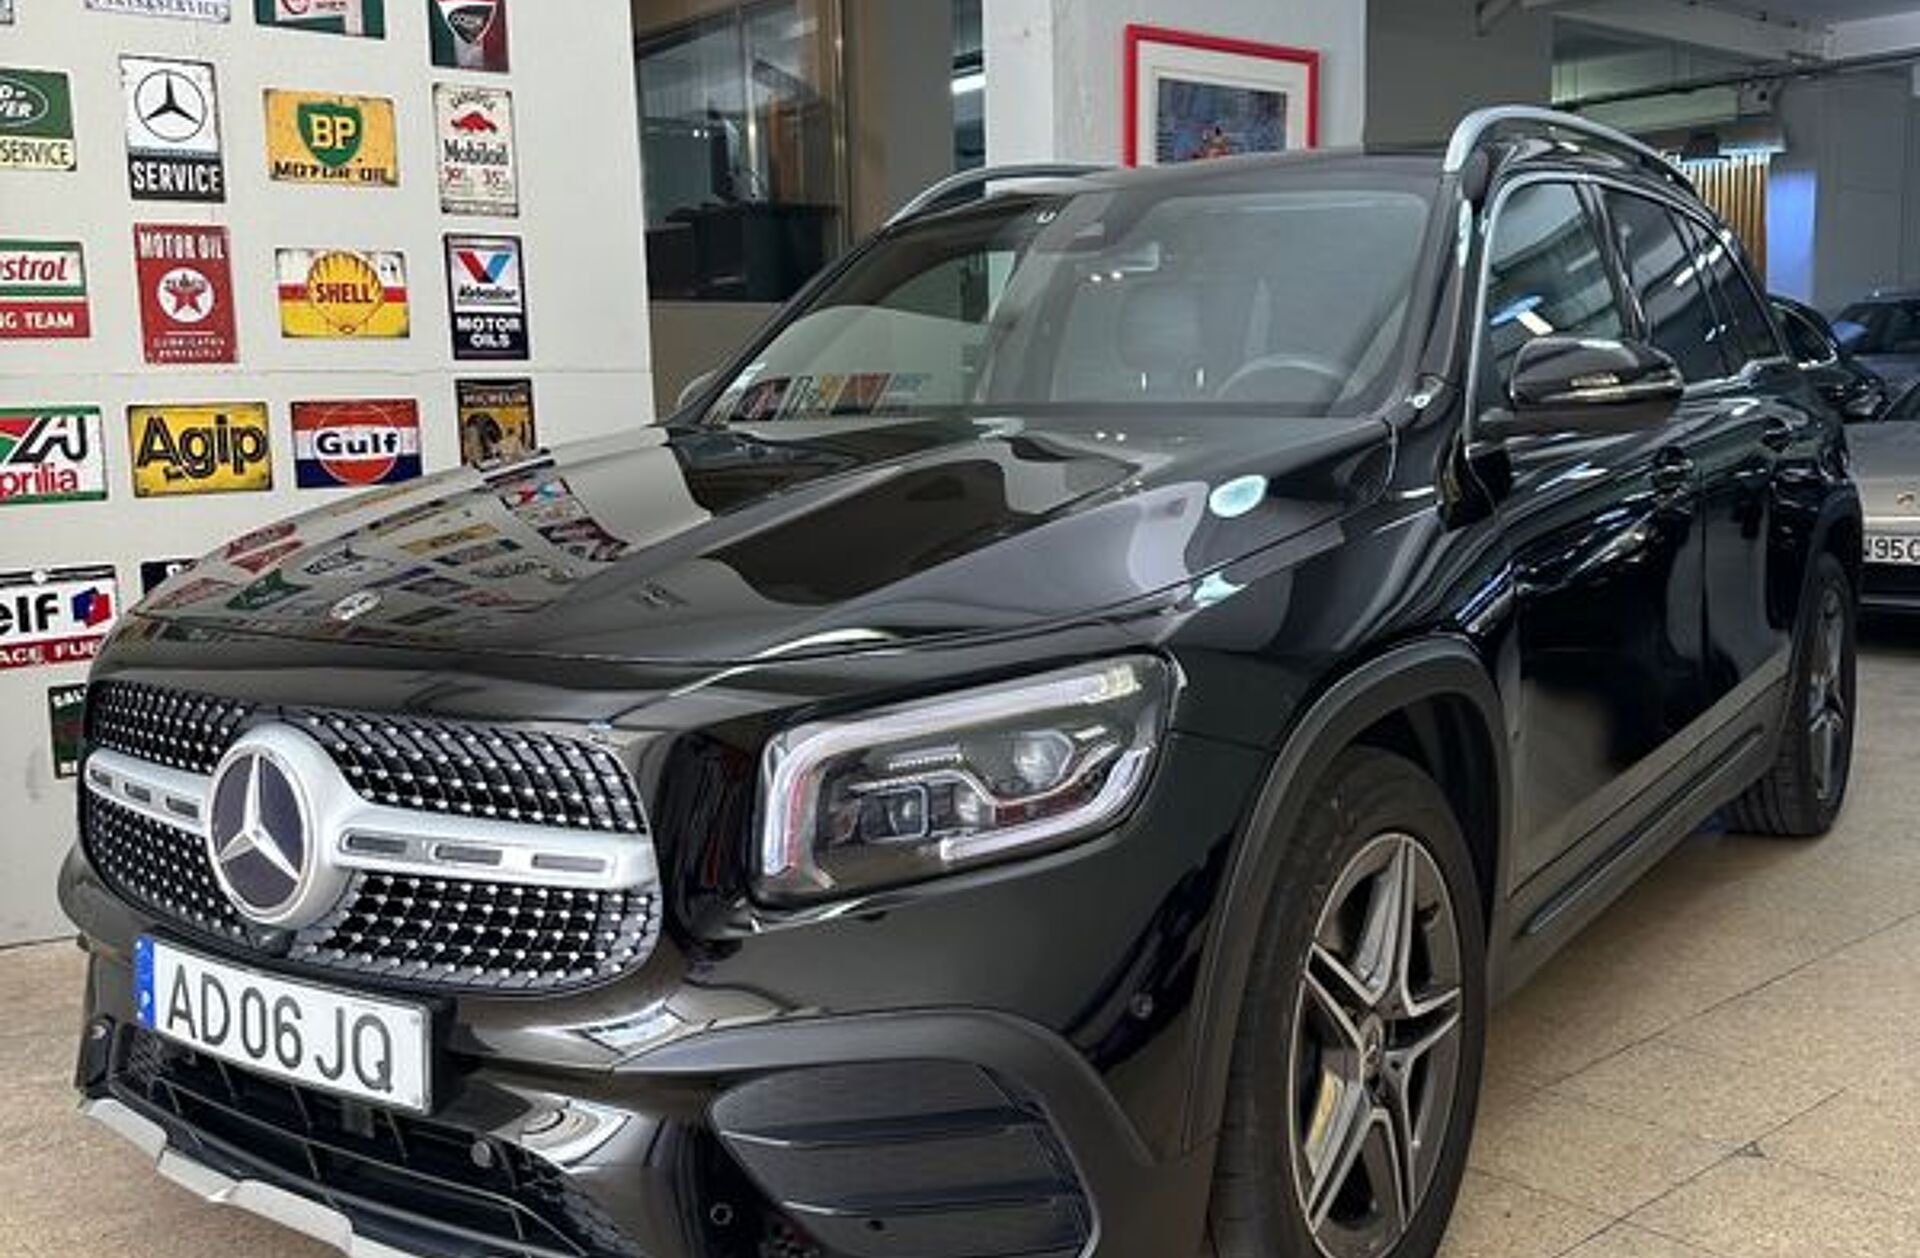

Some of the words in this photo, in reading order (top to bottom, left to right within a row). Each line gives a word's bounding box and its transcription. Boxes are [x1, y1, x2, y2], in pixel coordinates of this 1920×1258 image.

[308, 113, 356, 149] BP
[130, 161, 222, 193] SERVICE
[139, 232, 196, 259] MOTOR
[199, 234, 225, 259] OIL
[315, 283, 373, 304] SHELL
[24, 312, 75, 329] TEAM
[457, 317, 521, 333] MOTOR
[469, 333, 511, 348] OILS
[137, 415, 267, 479] Agip
[315, 432, 398, 455] Gulf
